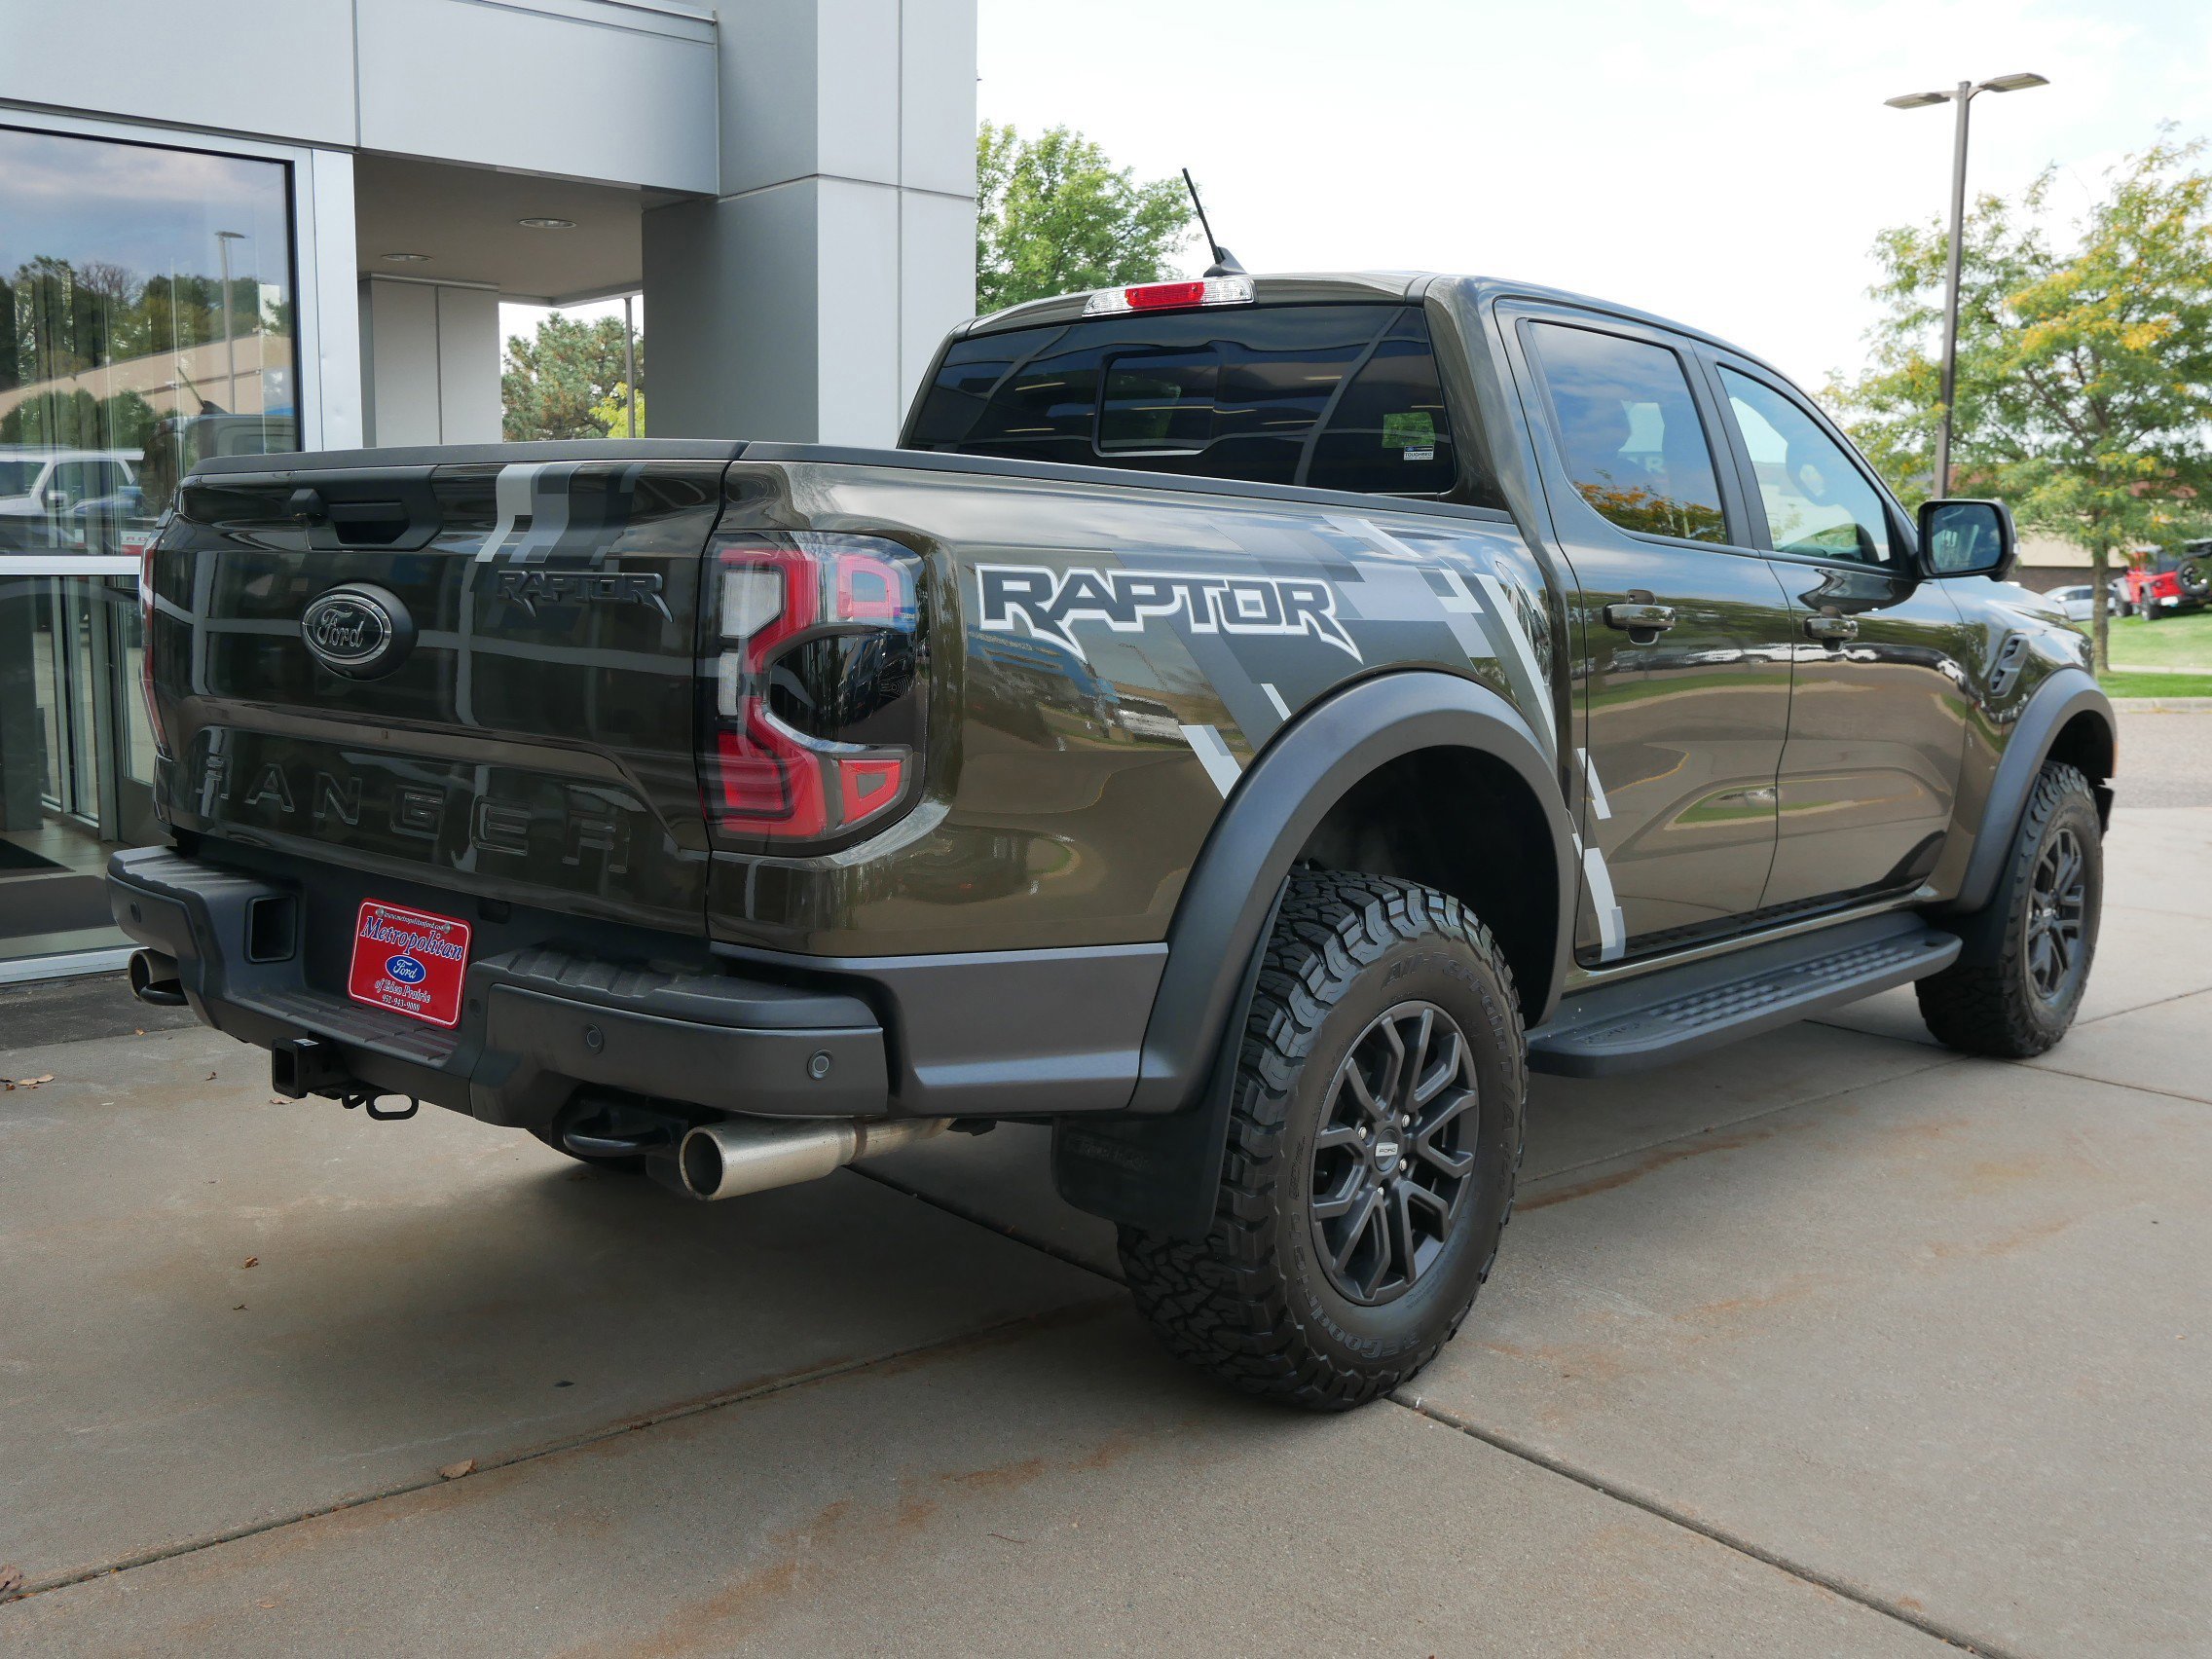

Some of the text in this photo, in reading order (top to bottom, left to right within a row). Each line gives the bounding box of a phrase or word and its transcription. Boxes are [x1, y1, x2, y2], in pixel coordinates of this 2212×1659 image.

[498, 571, 674, 623] RAPTOR
[975, 563, 1364, 665] RAPTOR
[316, 608, 364, 649] Ford
[196, 753, 630, 873] RANGER
[360, 916, 463, 961] Metropolitan
[393, 959, 418, 979] Ford
